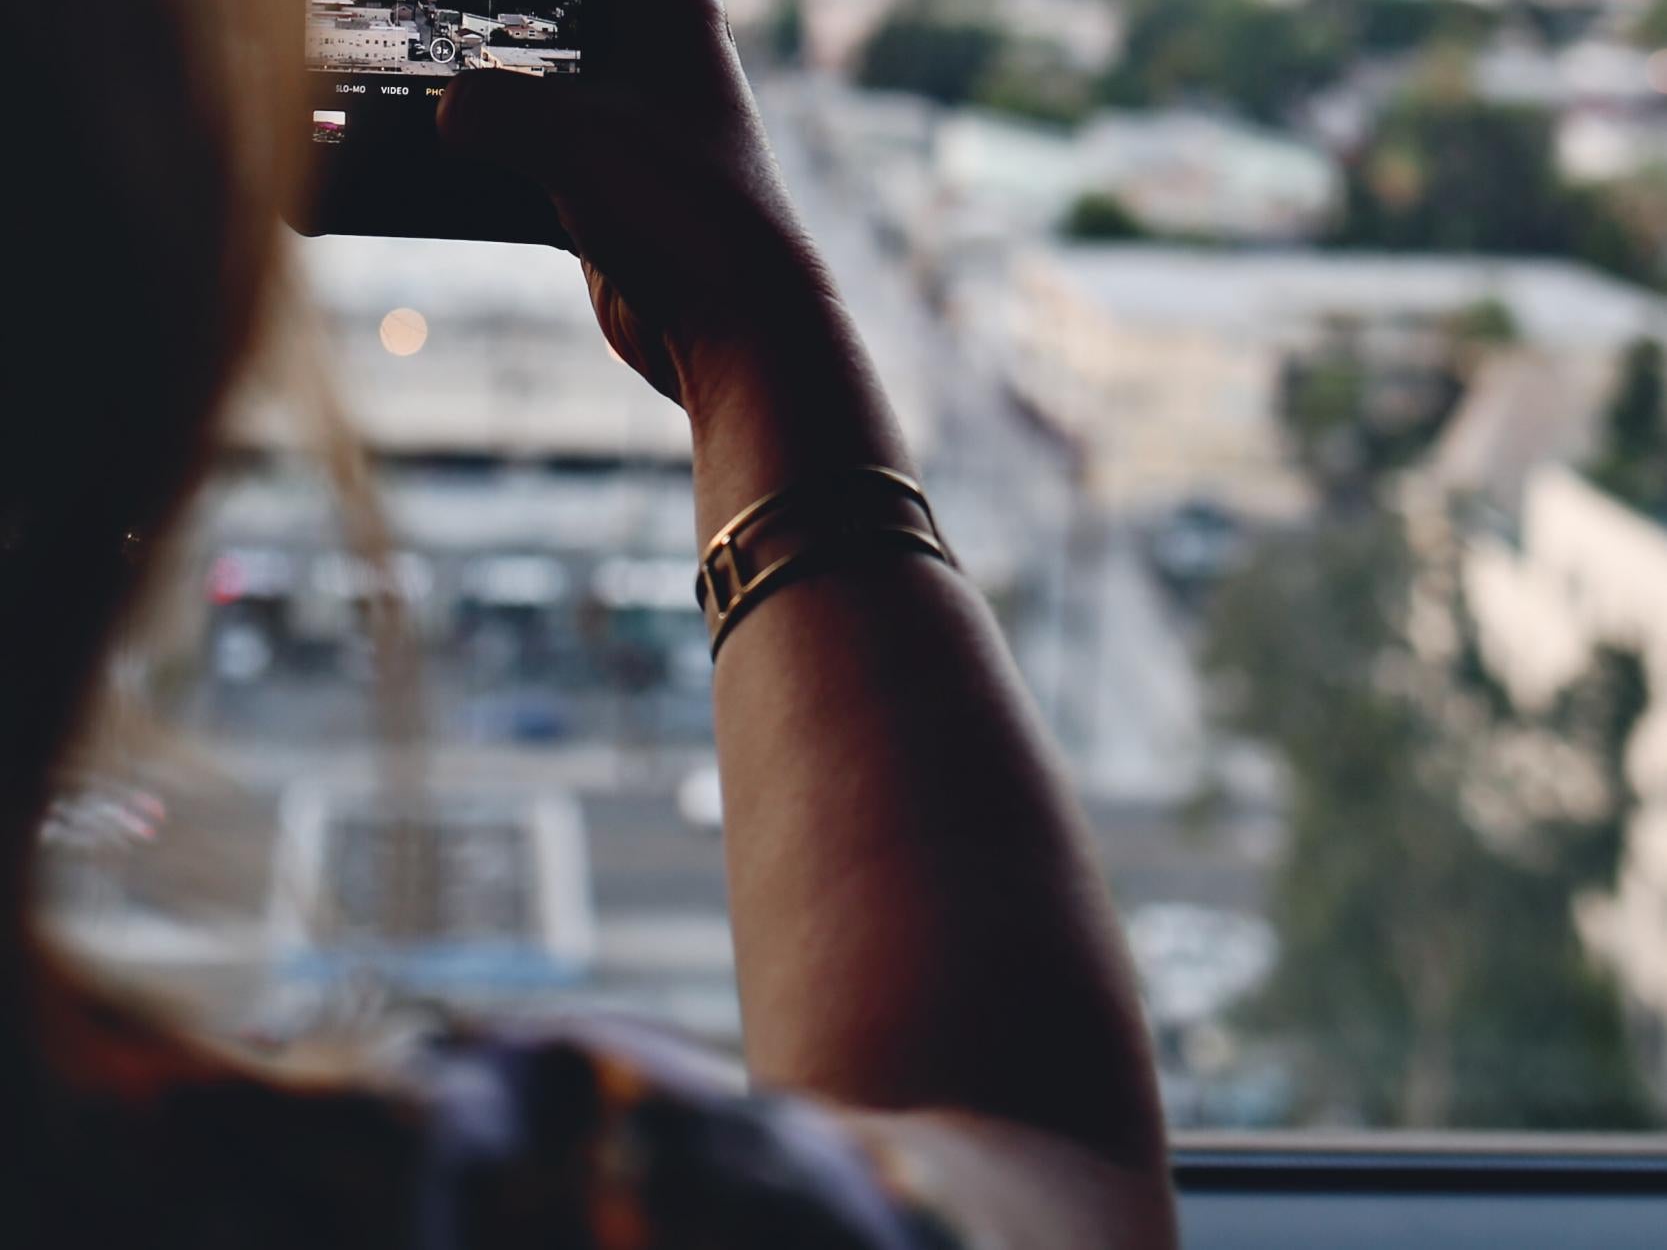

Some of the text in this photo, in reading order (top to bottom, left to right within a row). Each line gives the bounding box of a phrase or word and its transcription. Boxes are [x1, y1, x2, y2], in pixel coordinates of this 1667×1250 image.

[436, 46, 449, 55] 3x
[335, 84, 445, 97] SLO-MO VIDEO PHO
